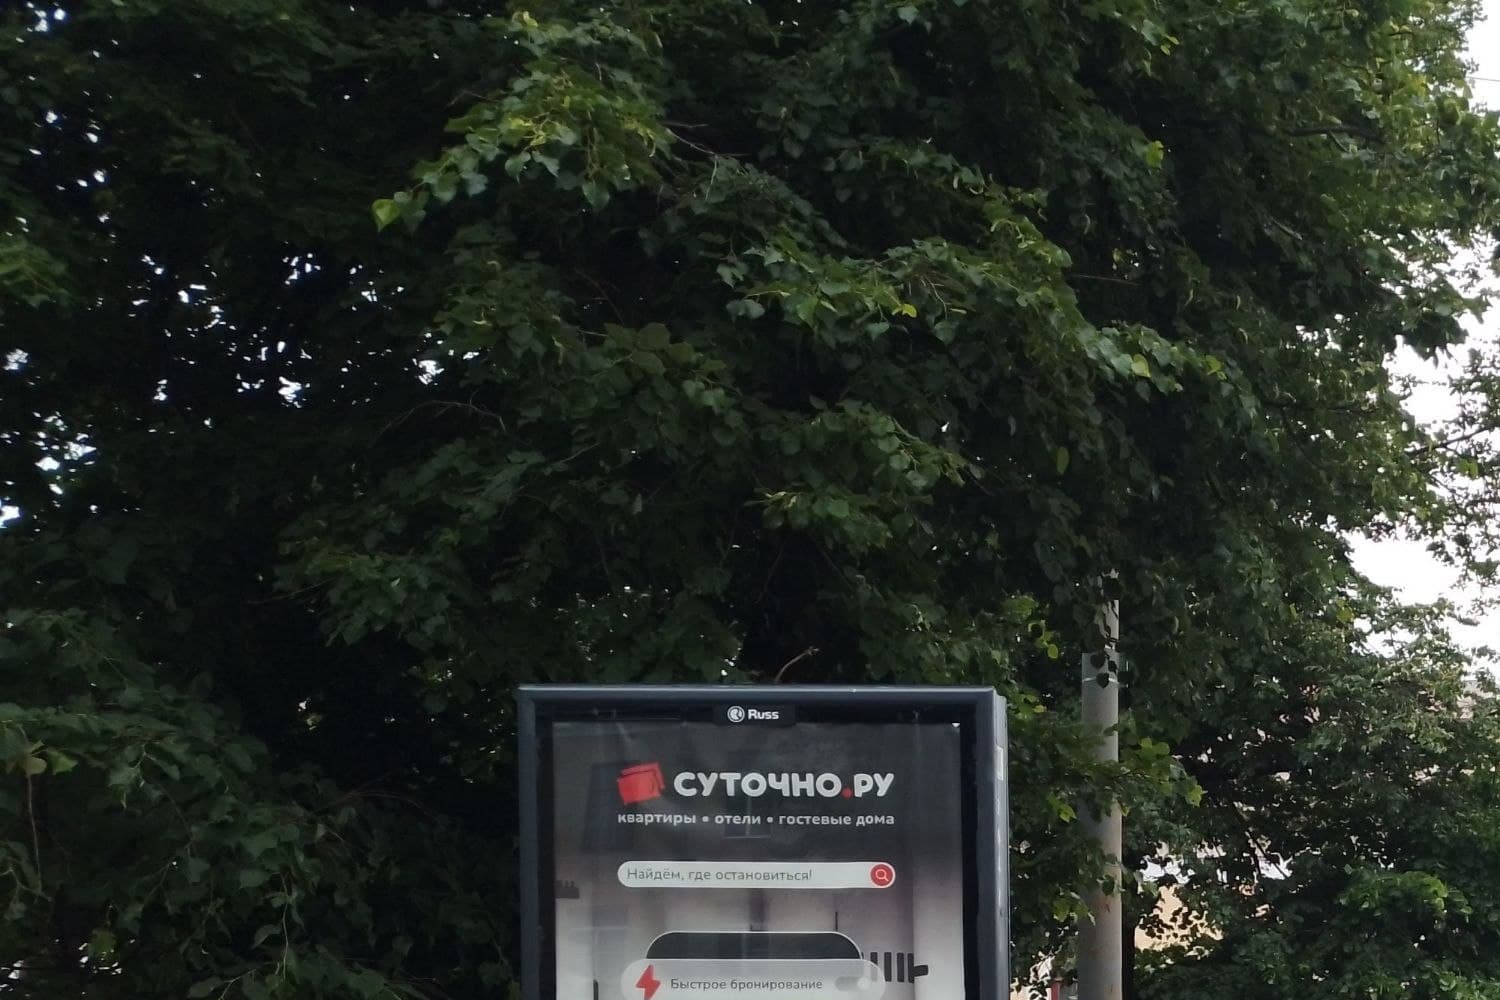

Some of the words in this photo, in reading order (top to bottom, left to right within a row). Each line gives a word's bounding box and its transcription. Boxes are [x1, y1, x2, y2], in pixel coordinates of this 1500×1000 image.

[748, 709, 779, 720] Russ
[673, 771, 895, 798] СУТОЧНО.РУ
[618, 813, 696, 826] квартиры
[714, 815, 761, 825] отели
[779, 815, 852, 825] гостевые
[856, 815, 895, 826] дома
[627, 868, 684, 881] Найдём,
[688, 870, 711, 881] где
[715, 869, 812, 881] остановиться!
[670, 978, 727, 990] Быстрое
[730, 978, 823, 990] бронирование
